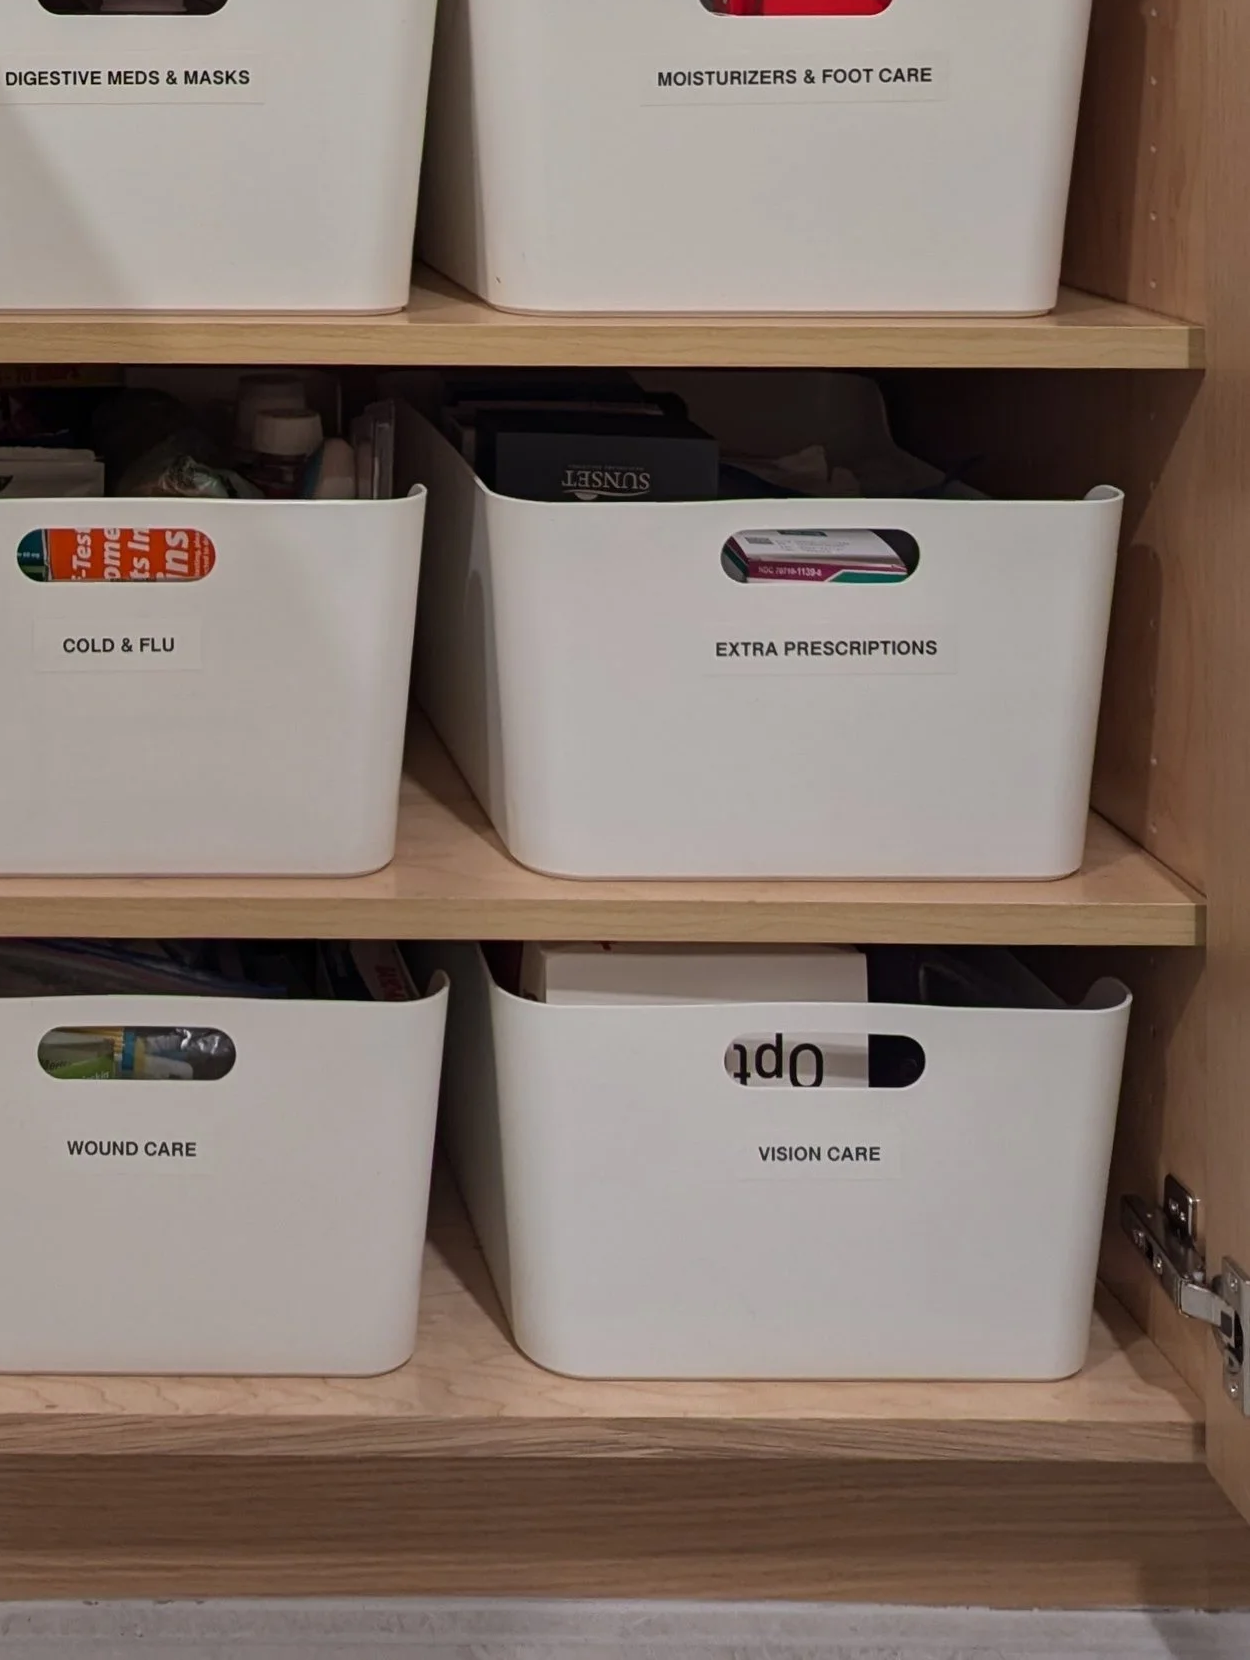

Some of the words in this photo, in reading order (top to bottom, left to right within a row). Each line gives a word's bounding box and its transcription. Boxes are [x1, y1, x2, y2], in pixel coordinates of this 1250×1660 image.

[5, 70, 102, 87] DIGESTIVE
[107, 70, 160, 86] MEDS
[165, 70, 178, 86] &
[183, 69, 250, 86] MASKS
[657, 69, 798, 87] MOISTURIZERS
[803, 68, 817, 85] &
[822, 68, 874, 84] FOOT
[878, 67, 933, 84] CARE
[561, 470, 650, 490] SUNSET
[62, 637, 115, 654] COLD
[120, 637, 134, 653] &
[139, 637, 175, 653] FLU
[715, 641, 779, 657] EXTRA
[784, 639, 938, 657] PRESCRIPTIONS
[66, 1140, 139, 1157] WOUND
[143, 1141, 197, 1157] CARE
[758, 1145, 822, 1162] VISION
[826, 1146, 881, 1162] CARE
